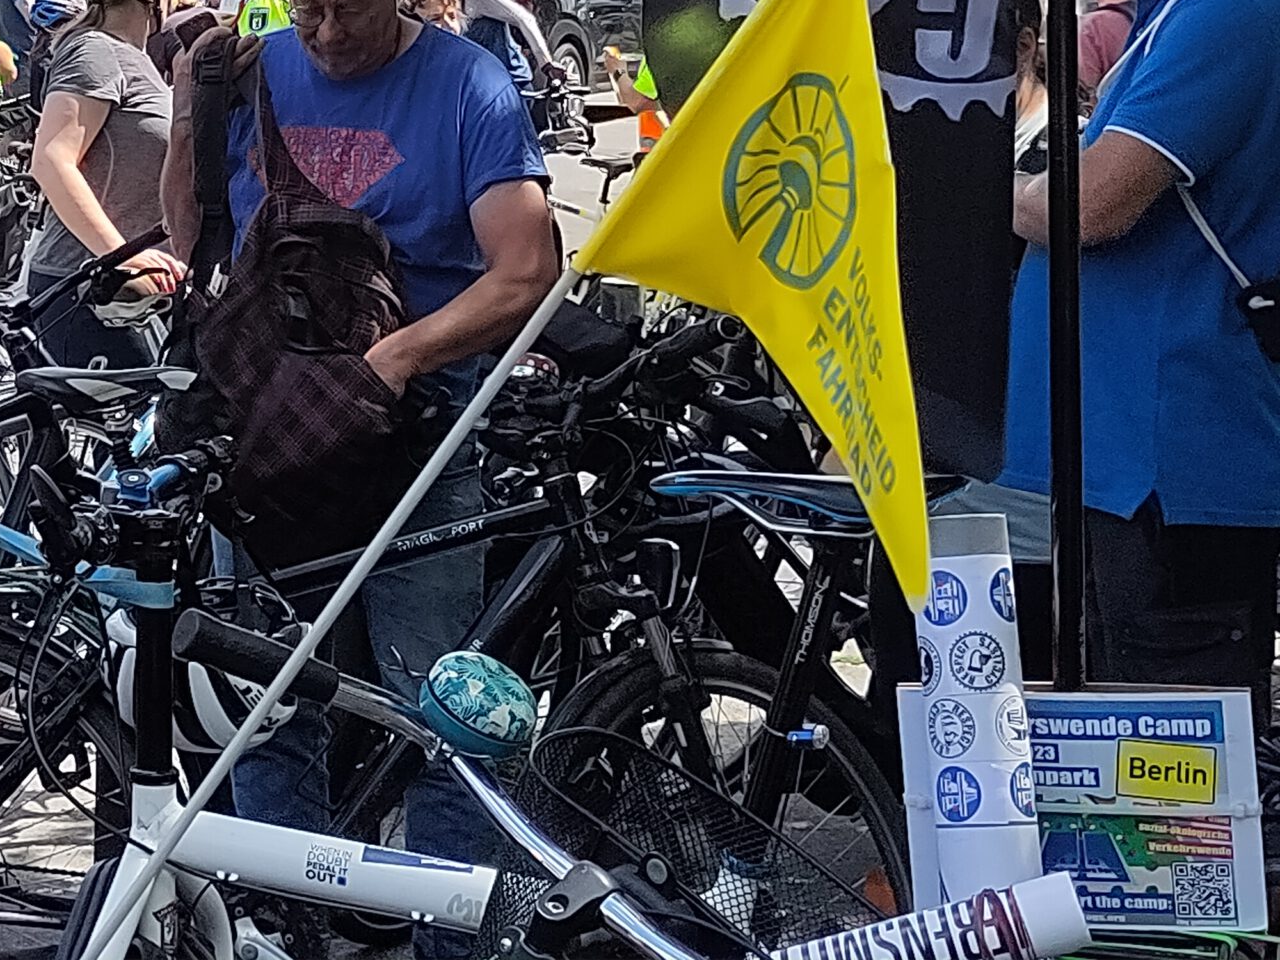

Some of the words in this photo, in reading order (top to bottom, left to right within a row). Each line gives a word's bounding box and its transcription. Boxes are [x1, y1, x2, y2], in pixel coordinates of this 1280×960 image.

[1137, 715, 1212, 739] Camp
[1128, 756, 1208, 787] Berlin
[309, 843, 341, 857] WHEN
[306, 851, 350, 868] DOUBT
[306, 860, 337, 874] PEDAL
[337, 867, 349, 876] IT
[305, 870, 336, 885] OUT
[1095, 895, 1122, 909] the
[1124, 897, 1173, 911] camp:
